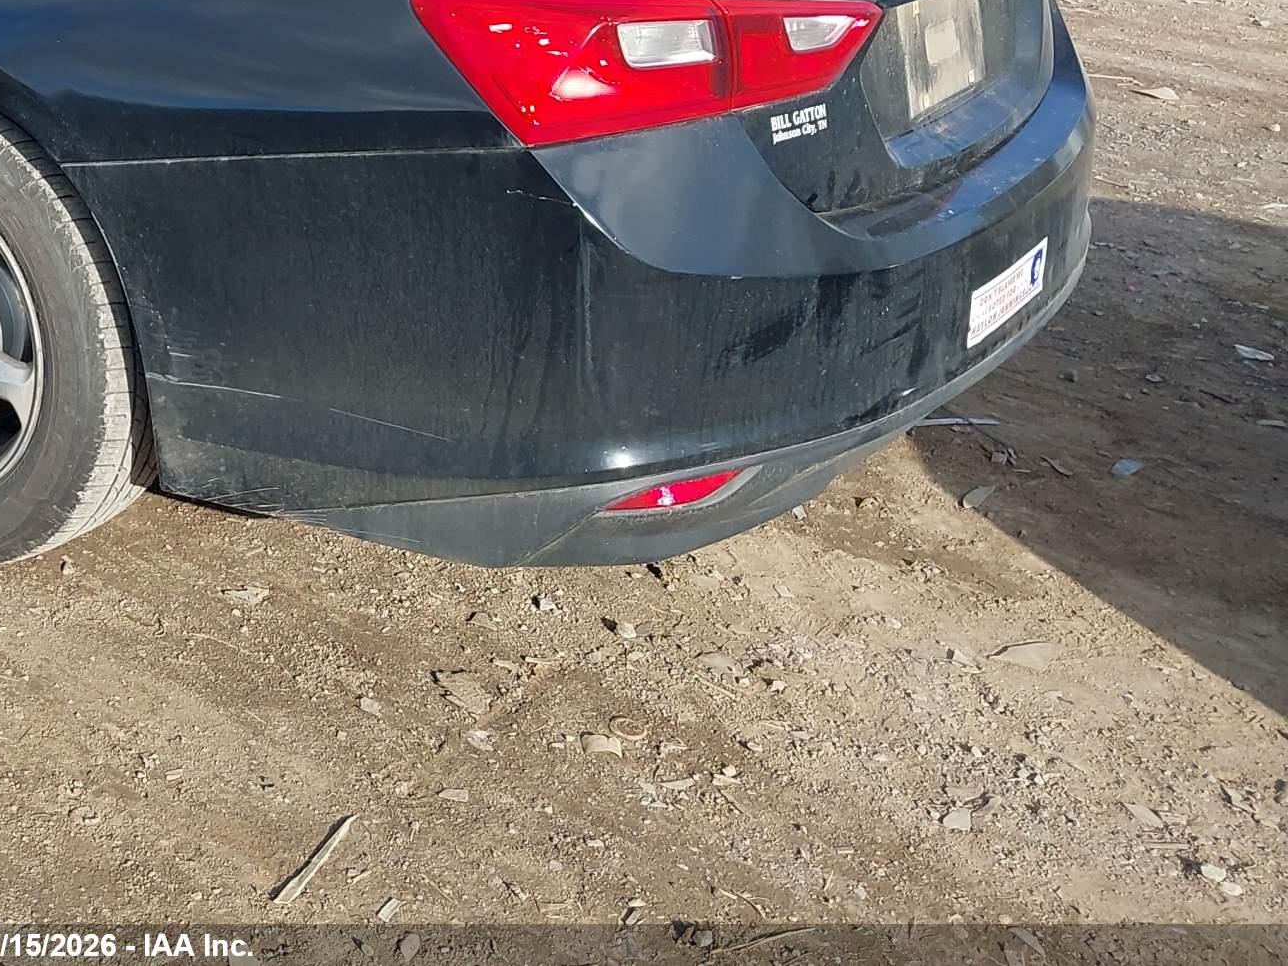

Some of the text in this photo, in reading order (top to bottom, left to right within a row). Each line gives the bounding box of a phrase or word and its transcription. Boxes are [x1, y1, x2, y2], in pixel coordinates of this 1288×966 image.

[771, 103, 827, 132] BILL GATTON
[773, 118, 828, 145] Johnson City, TN
